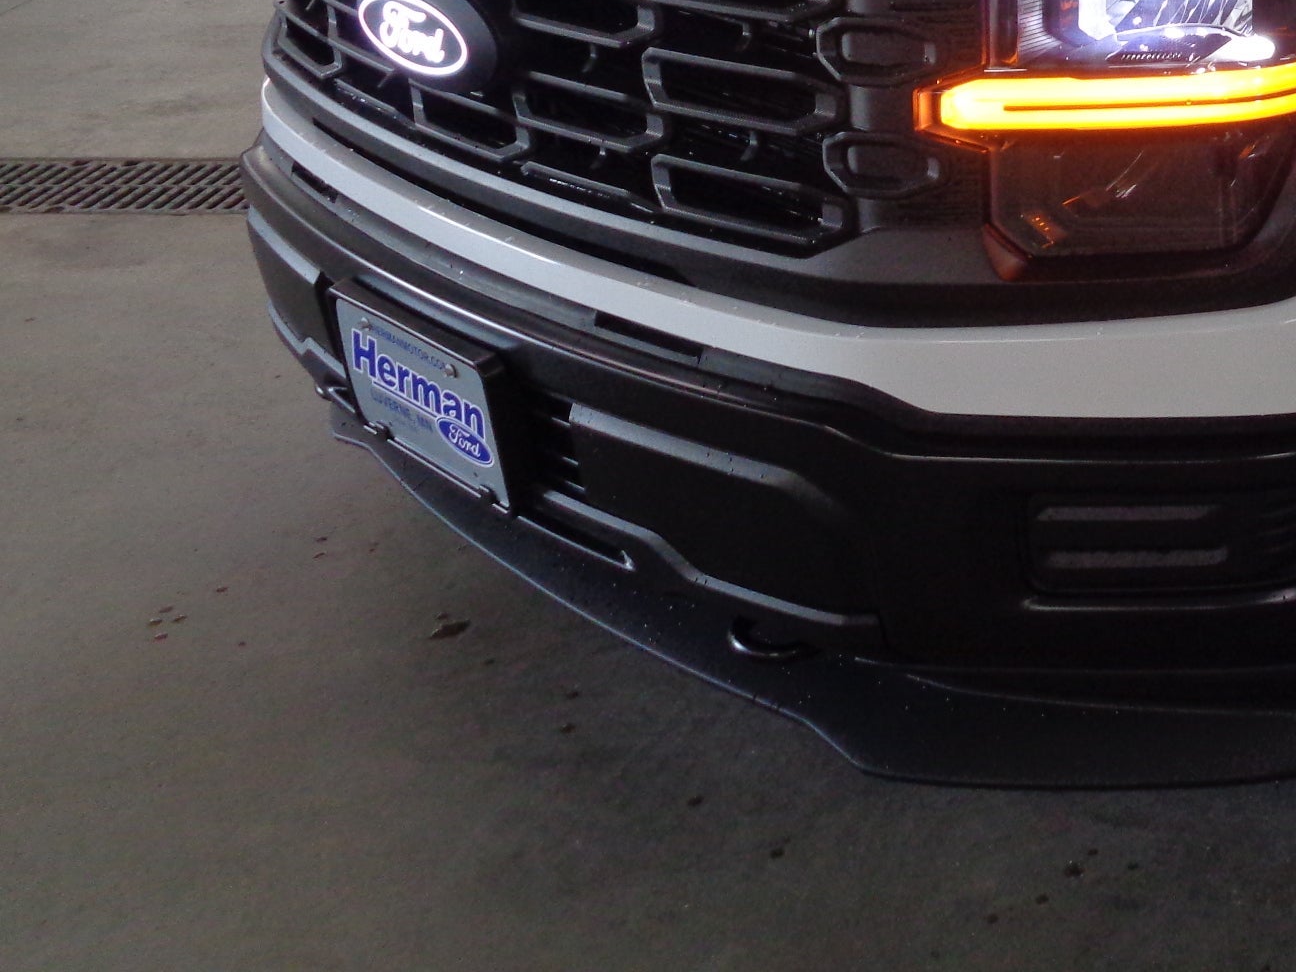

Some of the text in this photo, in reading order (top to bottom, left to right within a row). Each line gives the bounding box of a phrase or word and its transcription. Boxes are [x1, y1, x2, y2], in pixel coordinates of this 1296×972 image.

[379, 0, 445, 63] Ford
[351, 328, 486, 440] Herman
[449, 423, 481, 458] Ford
